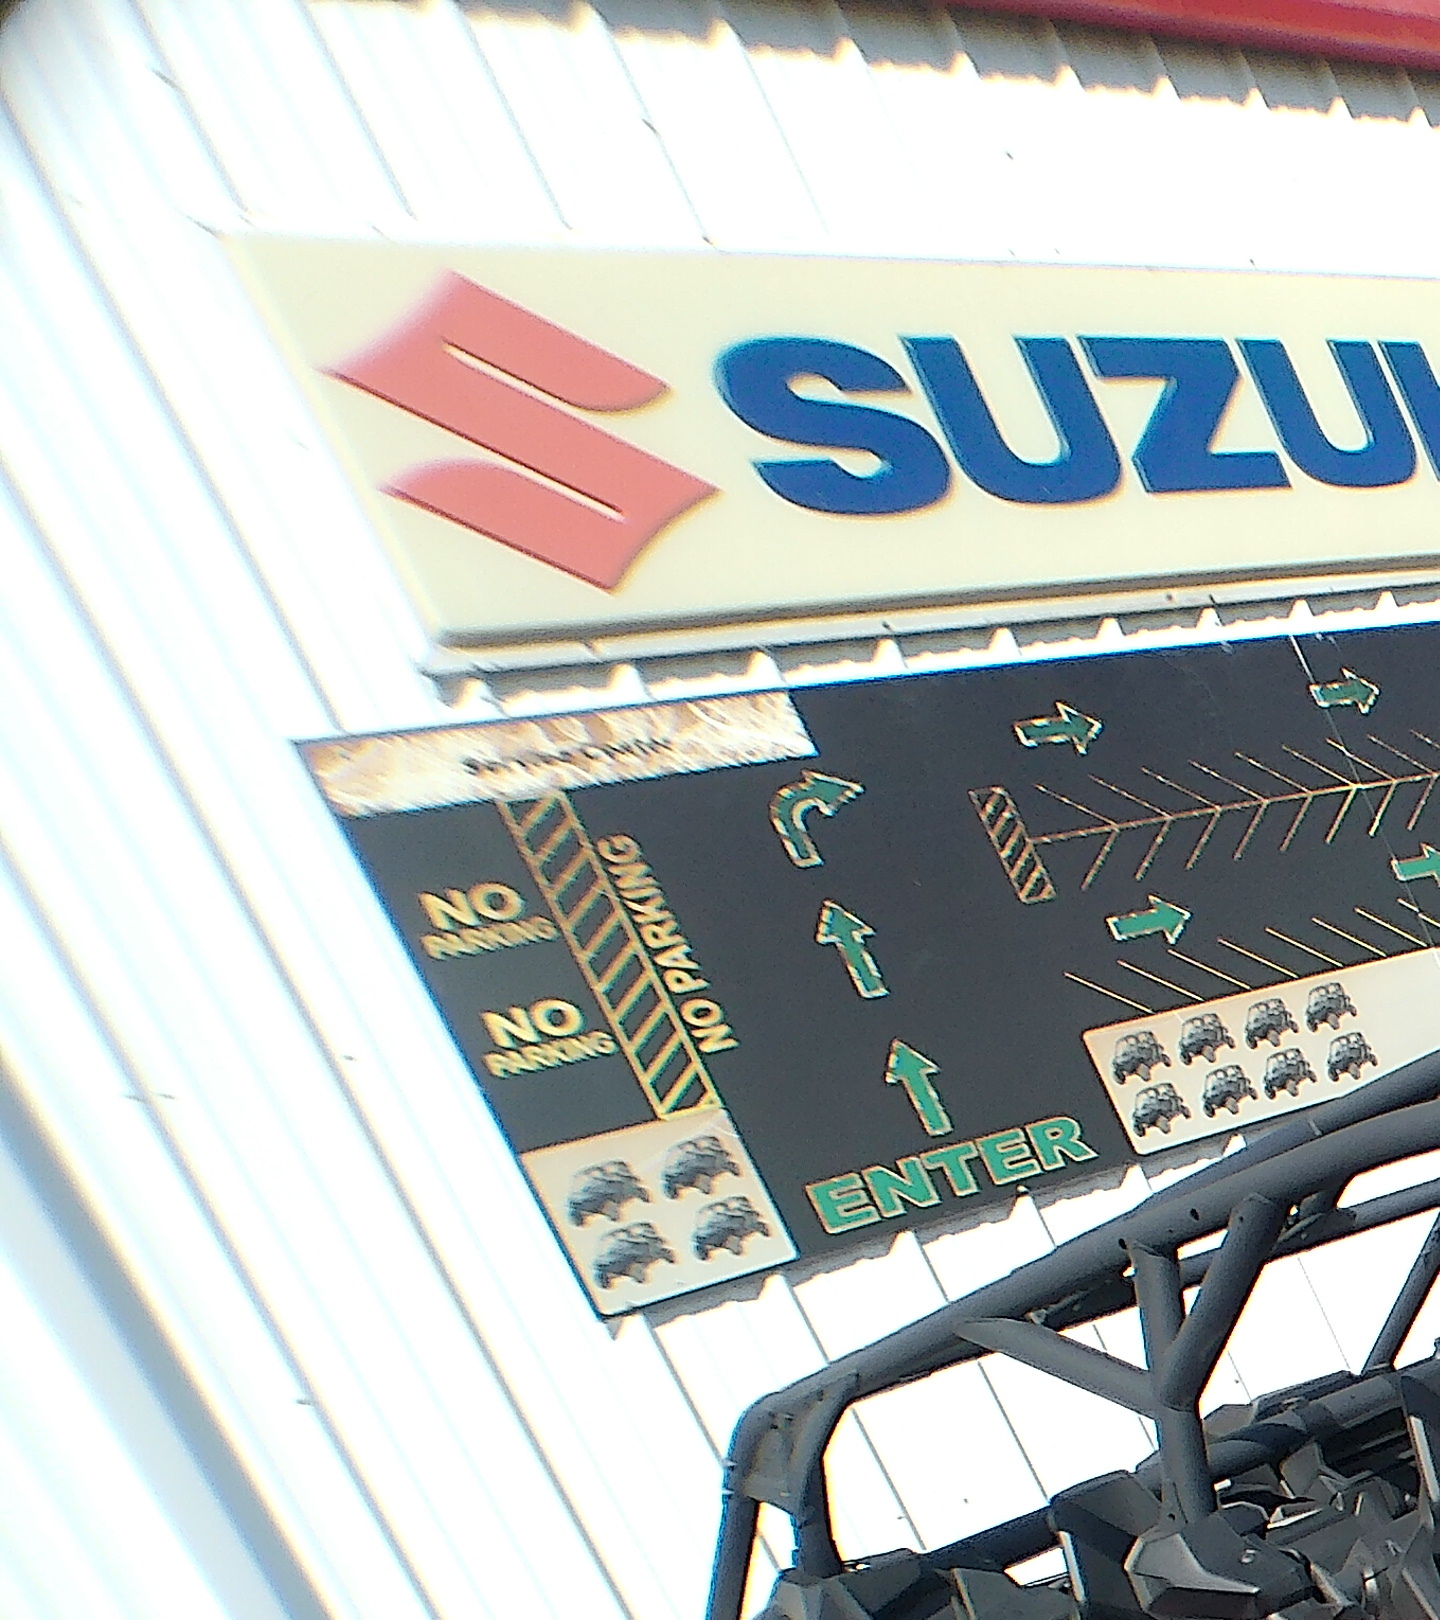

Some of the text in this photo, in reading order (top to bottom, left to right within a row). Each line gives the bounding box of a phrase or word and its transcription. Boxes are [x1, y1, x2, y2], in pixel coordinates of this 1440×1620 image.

[418, 882, 526, 931] NO
[598, 834, 739, 1054] NO PARKING
[481, 998, 586, 1047] NO
[482, 1031, 619, 1080] PARKING
[805, 1116, 1099, 1235] ENTER
